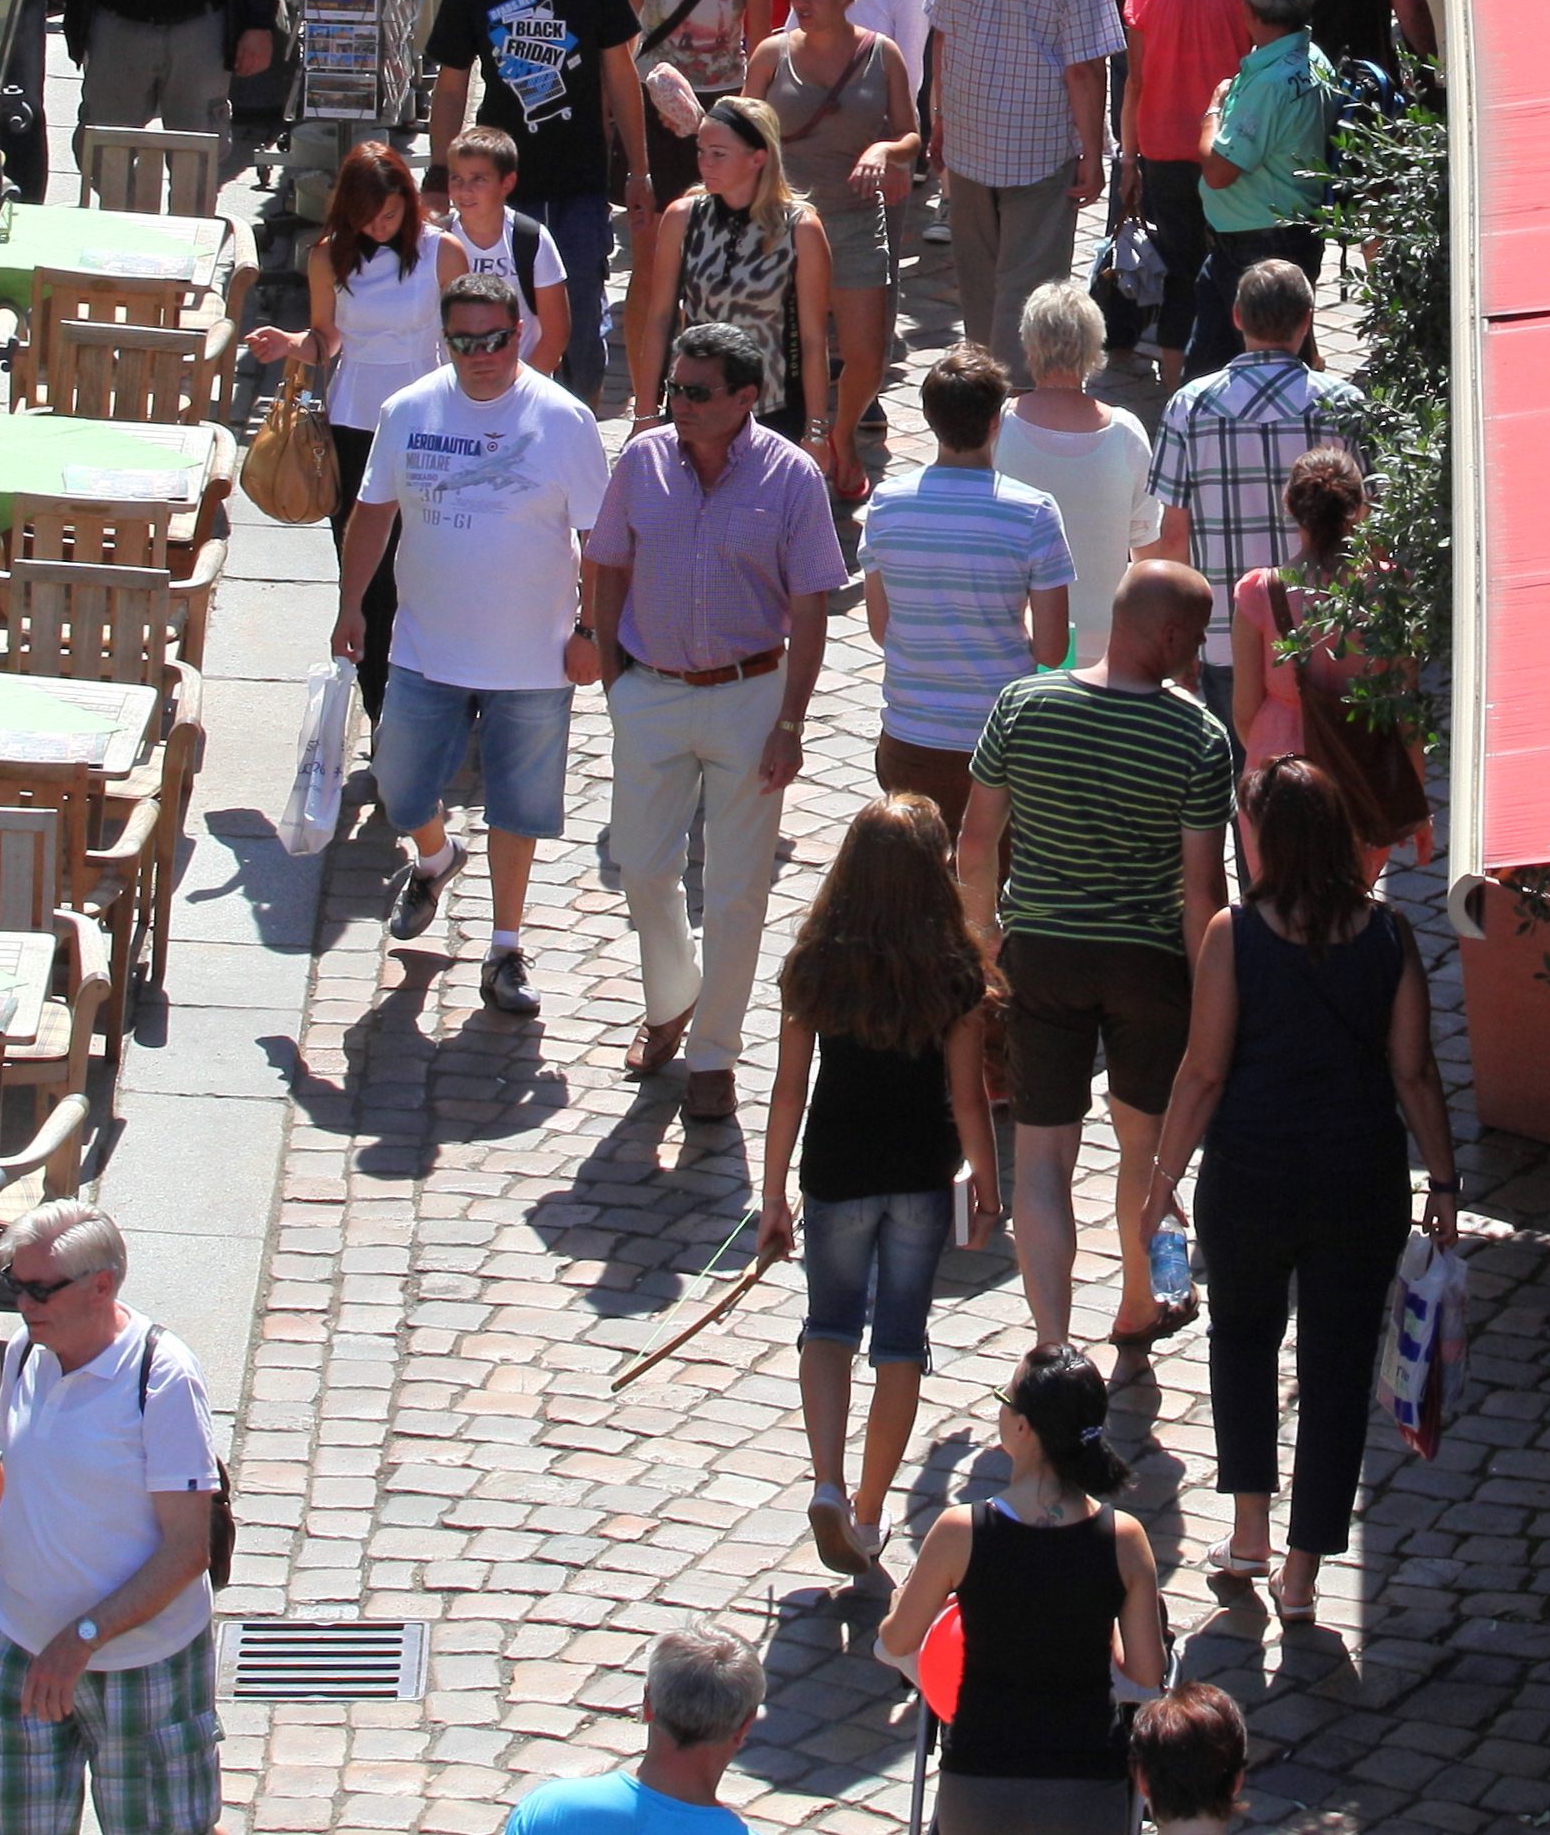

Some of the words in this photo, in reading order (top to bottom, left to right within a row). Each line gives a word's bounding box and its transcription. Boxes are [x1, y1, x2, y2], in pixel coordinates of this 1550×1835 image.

[515, 20, 564, 39] BLACK
[505, 38, 565, 67] FRIDAY
[406, 432, 482, 457] AERONAUTICA
[406, 452, 451, 472] MILITARE
